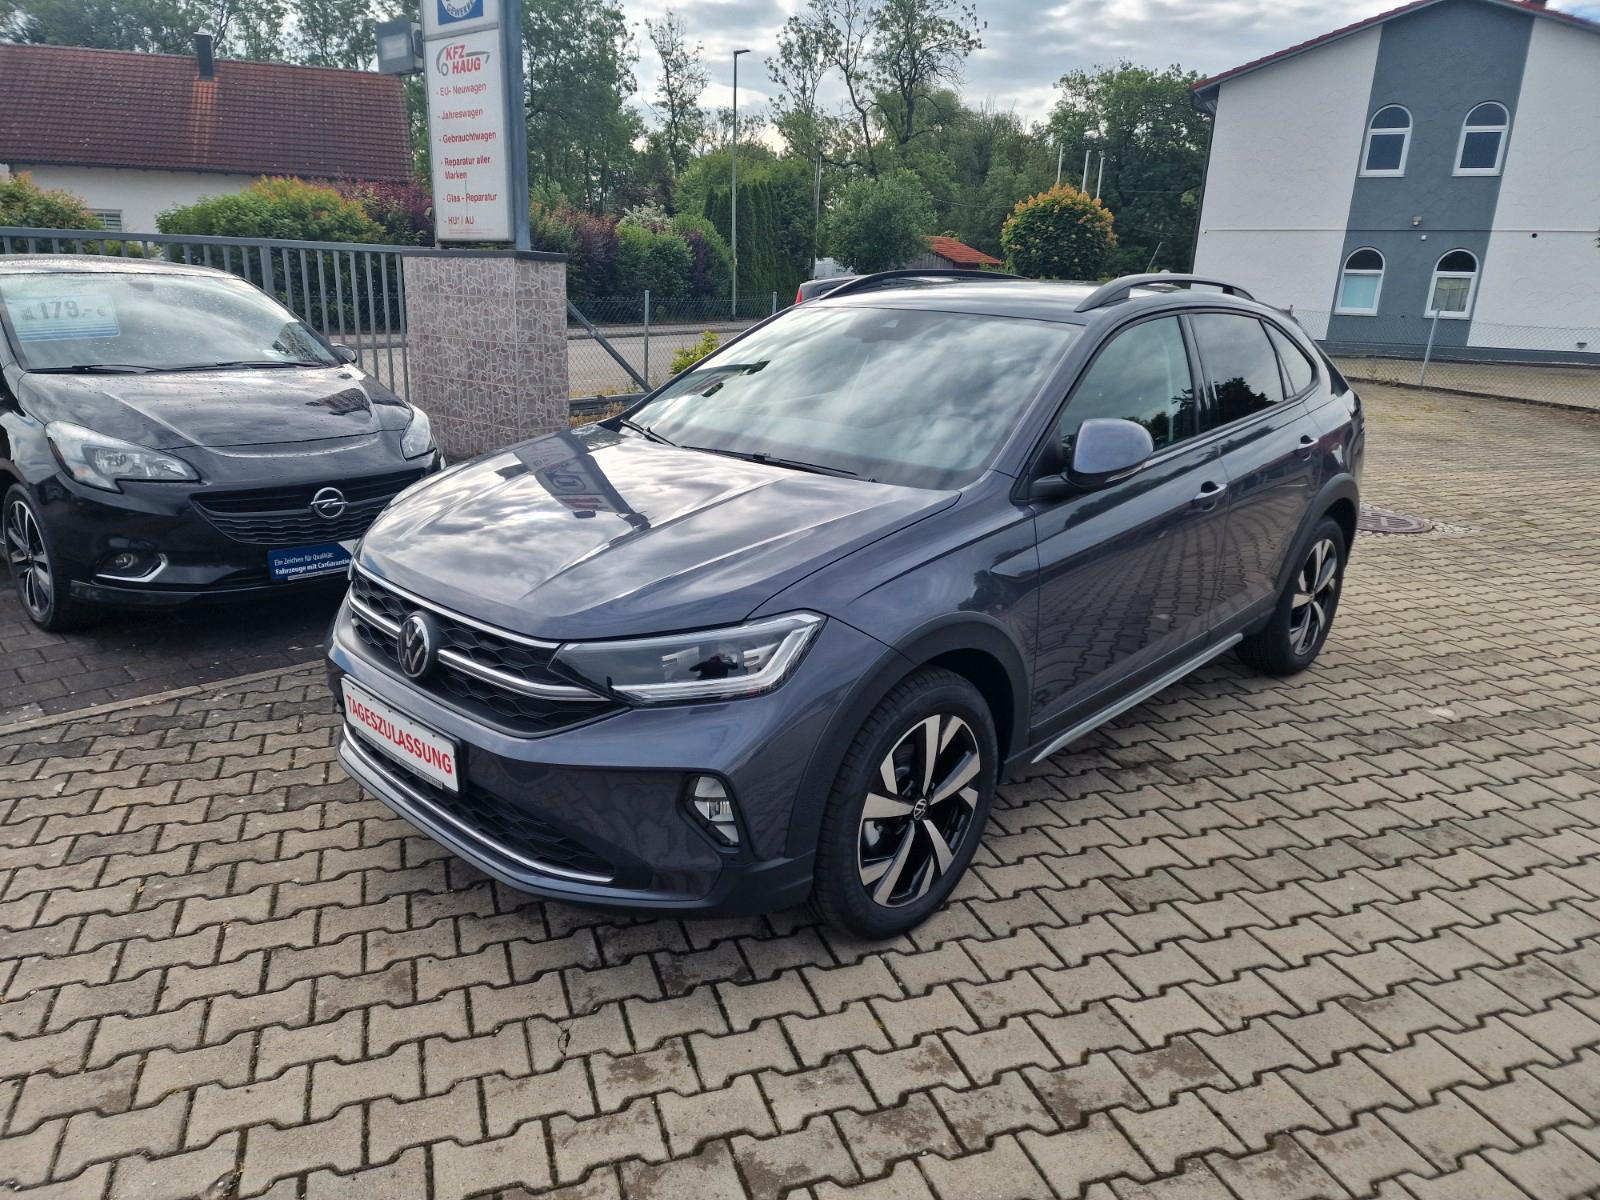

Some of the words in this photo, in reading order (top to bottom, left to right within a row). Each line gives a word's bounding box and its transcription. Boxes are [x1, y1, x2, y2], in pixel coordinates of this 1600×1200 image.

[445, 45, 466, 60] KFZ
[452, 58, 481, 74] HAUG
[453, 83, 487, 95] Neuwagen
[442, 108, 483, 120] Jahreswagen
[443, 131, 497, 144] Gebrauchtwagen
[444, 156, 475, 168] Reparatur
[476, 155, 491, 165] aller
[445, 171, 468, 180] Marken
[446, 193, 461, 203] Glas
[466, 193, 497, 204] Reparatur
[465, 216, 475, 225] AU
[274, 559, 284, 567] Ein
[284, 557, 304, 565] Zeichen
[304, 554, 312, 562] für
[275, 565, 307, 575] Fahrzeuge
[307, 562, 317, 570] mit
[317, 558, 350, 569] CarGarantie
[346, 693, 453, 775] TAGESZULASSUNG
